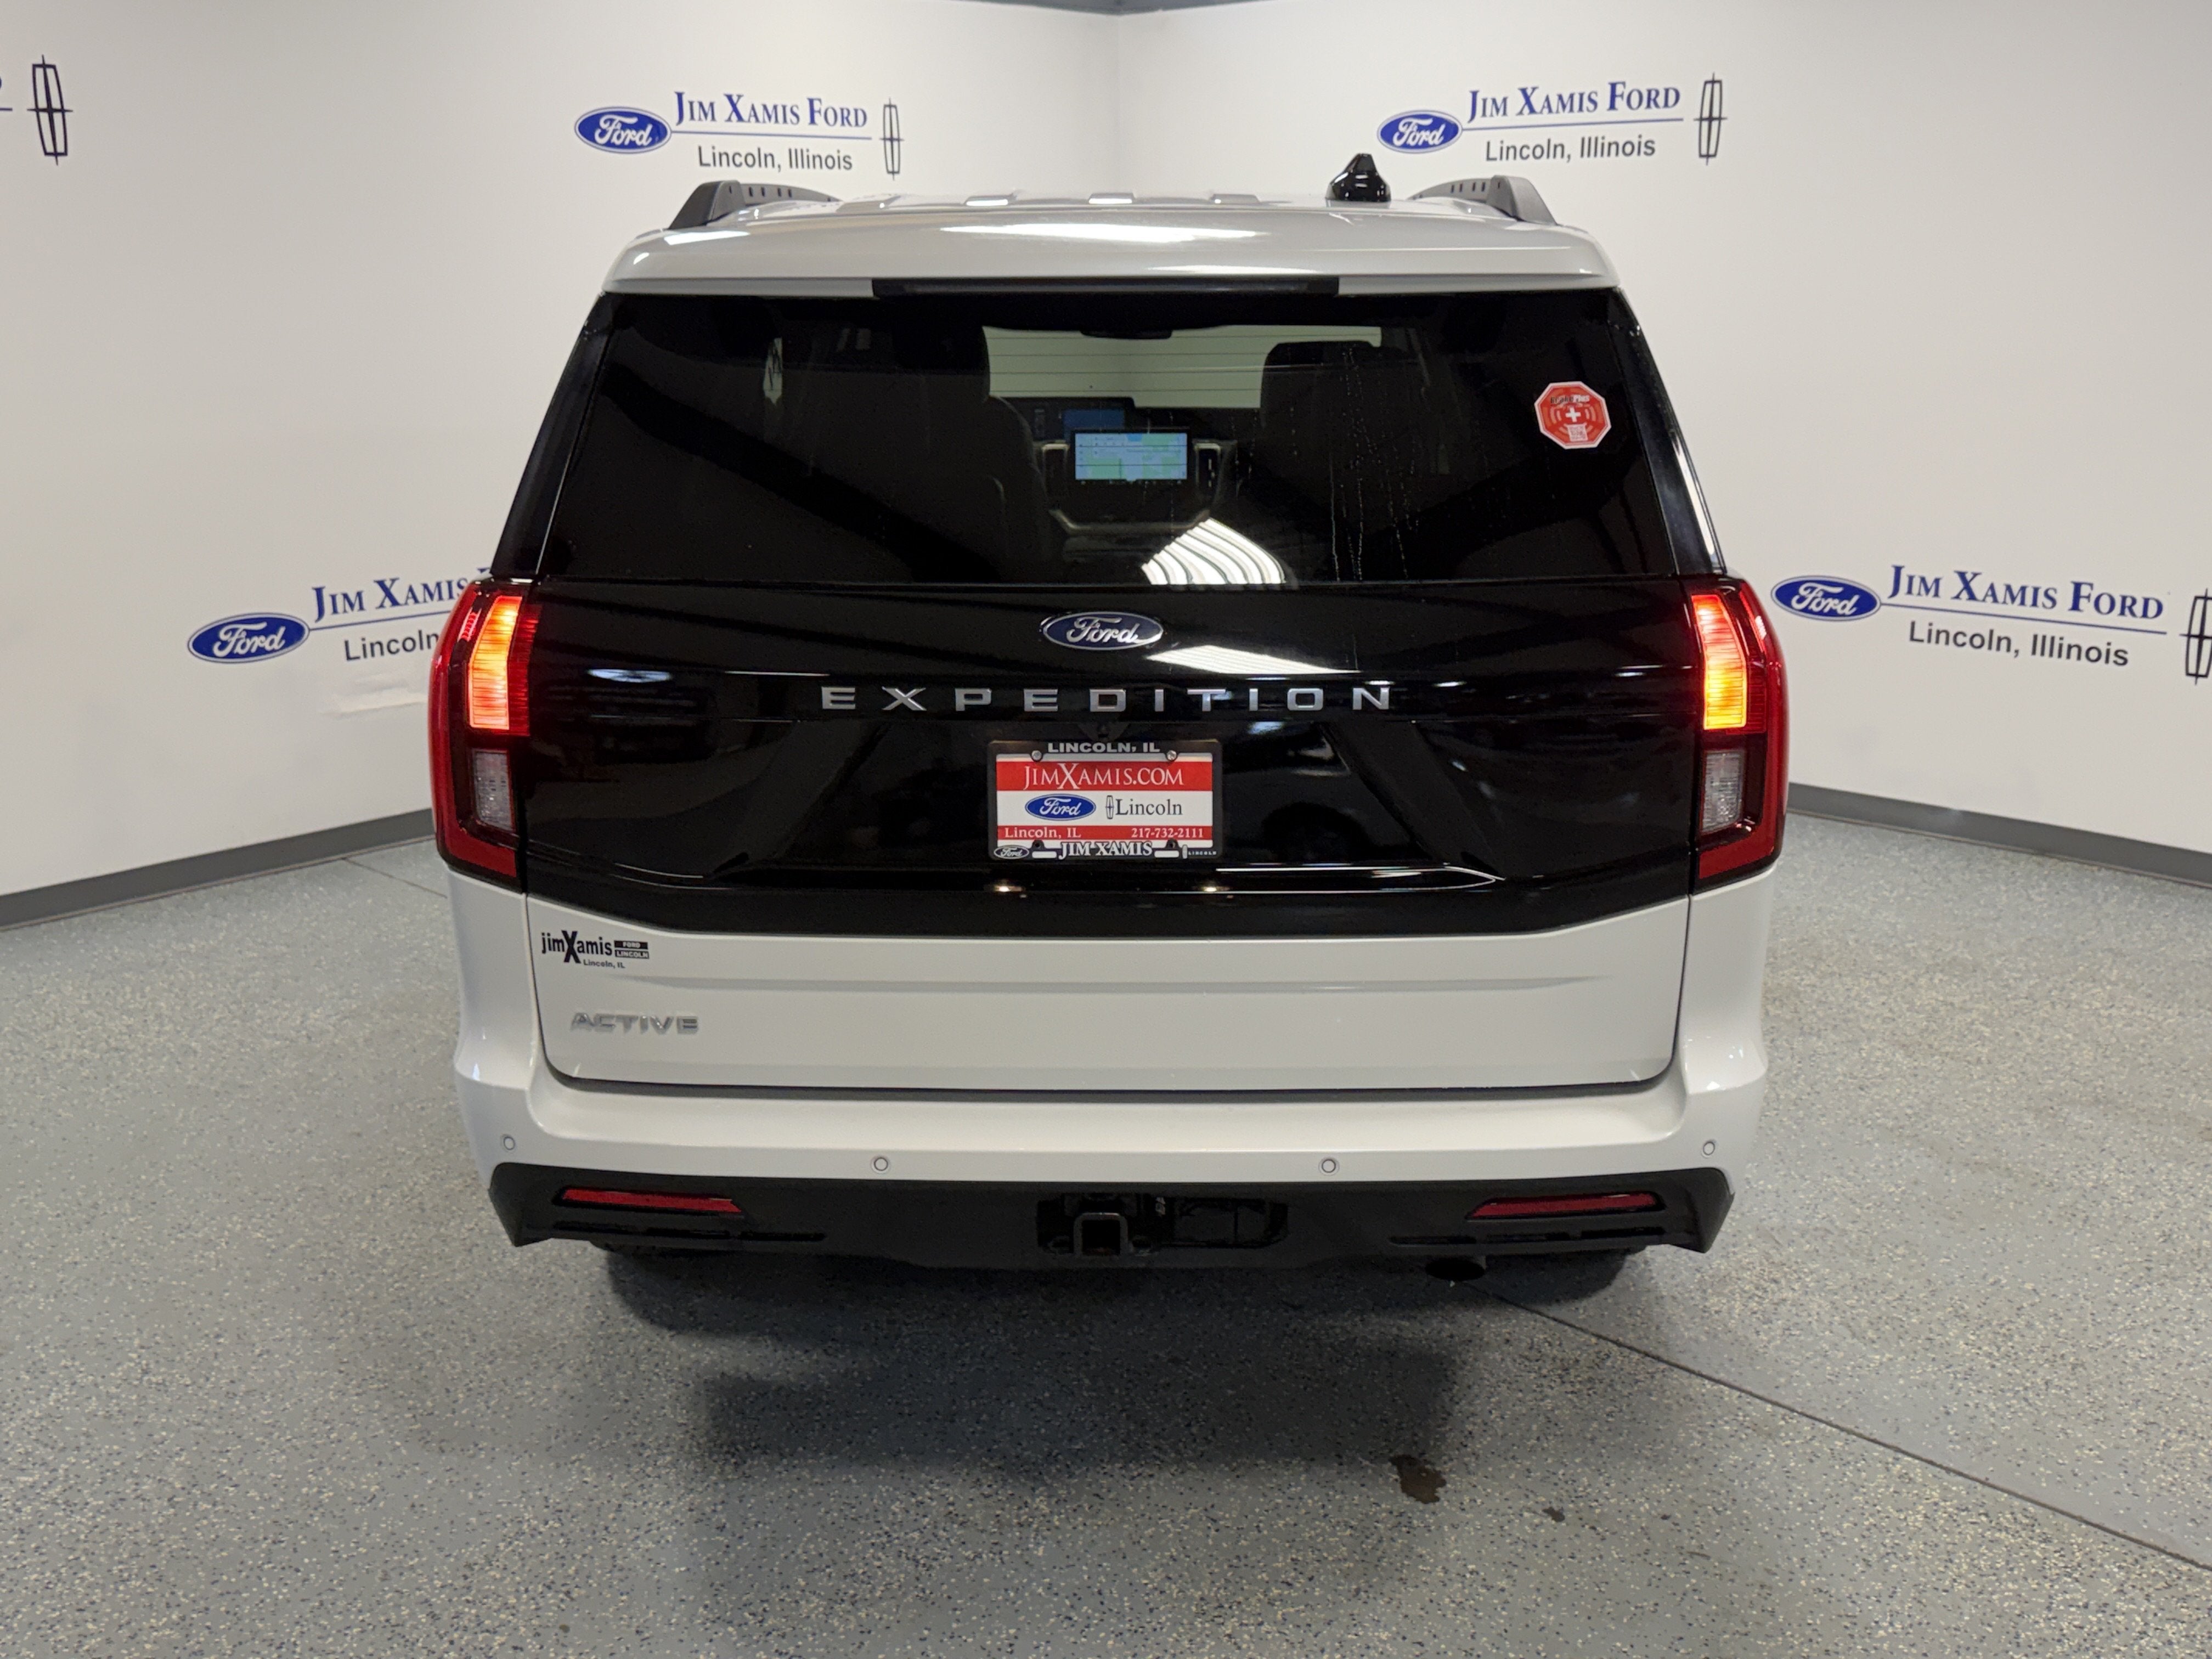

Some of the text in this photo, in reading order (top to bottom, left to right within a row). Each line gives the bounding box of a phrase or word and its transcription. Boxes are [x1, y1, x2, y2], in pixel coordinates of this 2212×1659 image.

[674, 92, 867, 128] JIM XAMIS FORD
[1468, 81, 1681, 123] JIM XAMIS FORD
[594, 114, 653, 146] Ford
[1392, 117, 1444, 146] Ford
[698, 145, 853, 172] Lincoln, Illinois
[1486, 134, 1656, 163] Lincoln, Illinois
[312, 585, 365, 623] JIM
[1791, 582, 1860, 616] Ford
[1888, 565, 2163, 619] JIM XAMIS FORD
[212, 622, 286, 657] Ford
[1066, 616, 1139, 644] Ford
[1909, 620, 2129, 666] Lincoln, Illinois
[821, 685, 1391, 712] EXPEDITION
[1047, 742, 1160, 753] LINCOLN, IL
[1024, 763, 1184, 790] JIMXAMIS.COM
[1039, 797, 1081, 816] Ford
[1115, 799, 1183, 815] Lincoln
[1005, 827, 1081, 839] Lincoln, IL
[1131, 828, 1203, 838] 217-732-2111
[1000, 847, 1023, 857] Ford
[1059, 841, 1153, 860] JIM XAMIS
[583, 959, 616, 968] Lincoln,
[616, 950, 648, 958] LINCOLN
[570, 1013, 699, 1034] ACTIVE
